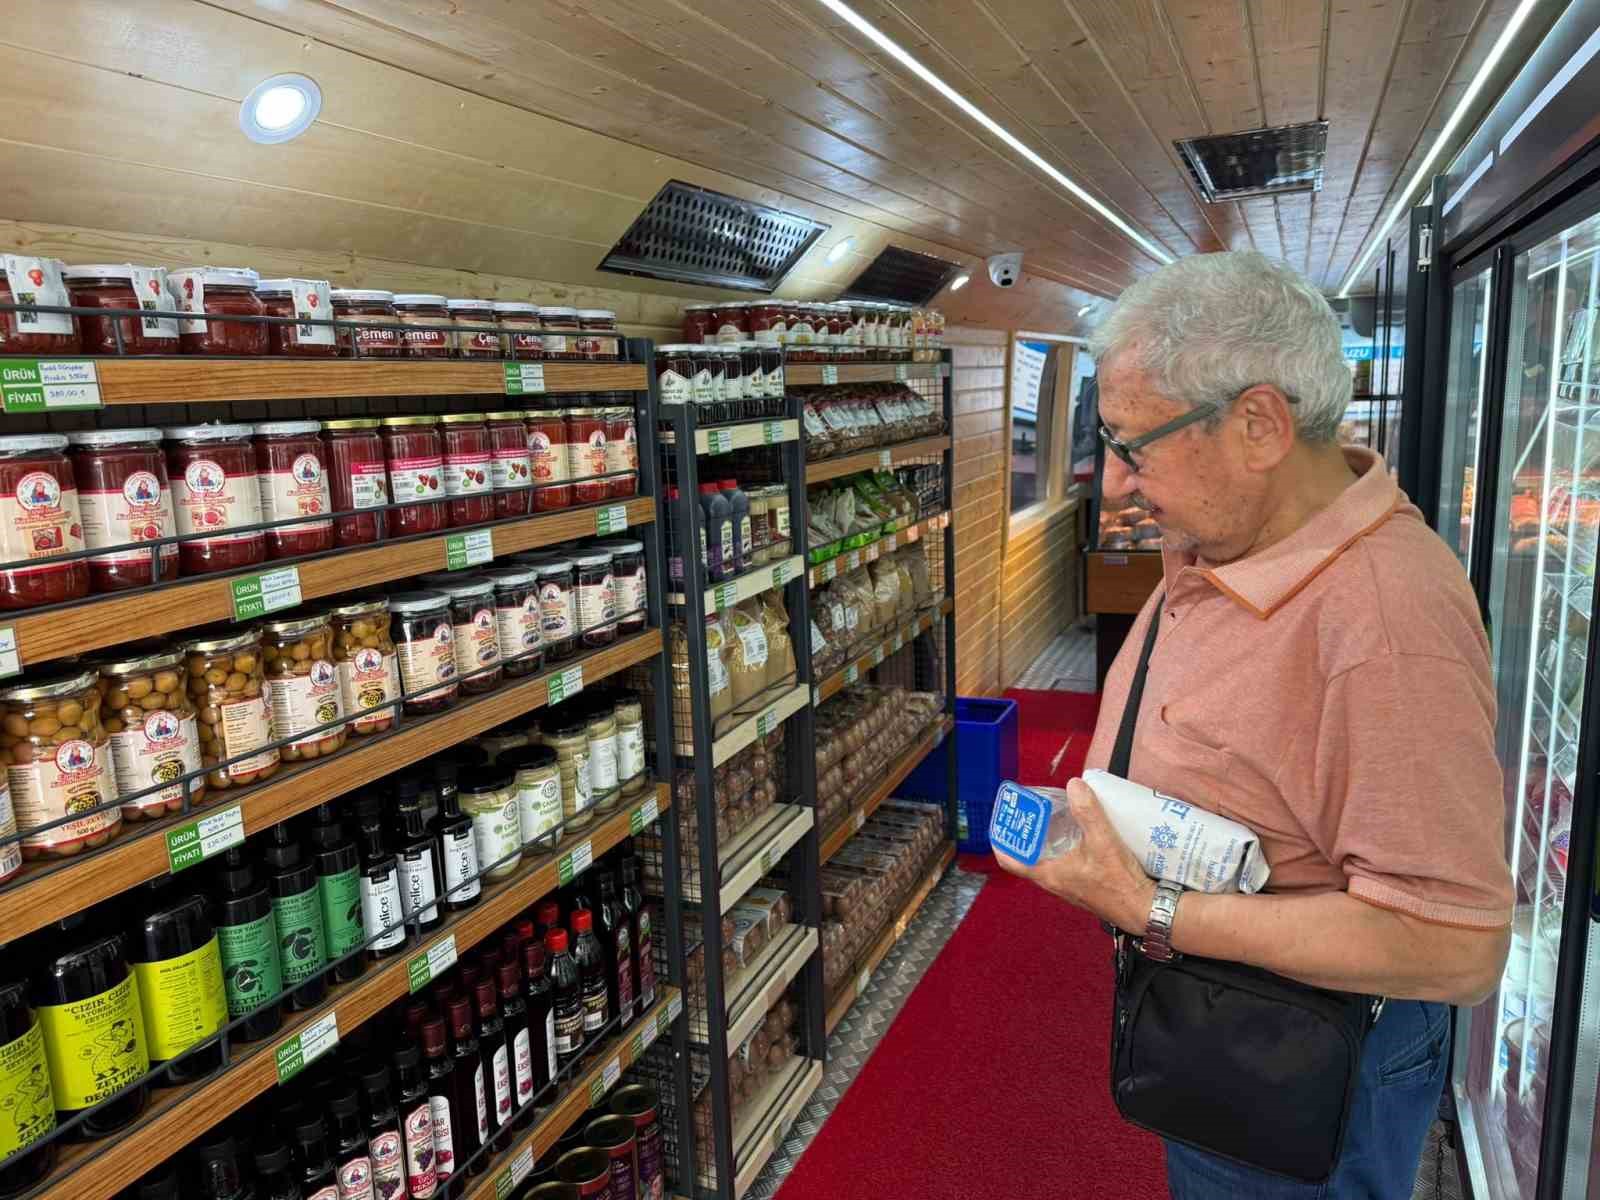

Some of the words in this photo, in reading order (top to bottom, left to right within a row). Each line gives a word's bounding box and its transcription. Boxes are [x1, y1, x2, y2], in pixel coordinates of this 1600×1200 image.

[400, 329, 438, 340] emen
[3, 367, 36, 381] ÜRÜN
[8, 391, 42, 404] FİYATI
[235, 583, 258, 595] ÜRÜN
[239, 601, 263, 615] FİYATI
[171, 830, 196, 846] ÜRÜN
[174, 848, 200, 865] FİYATI
[278, 1042, 299, 1060] ÜRÜN
[280, 1056, 303, 1077] FİYATI
[97, 1064, 138, 1090] ZEYTİN
